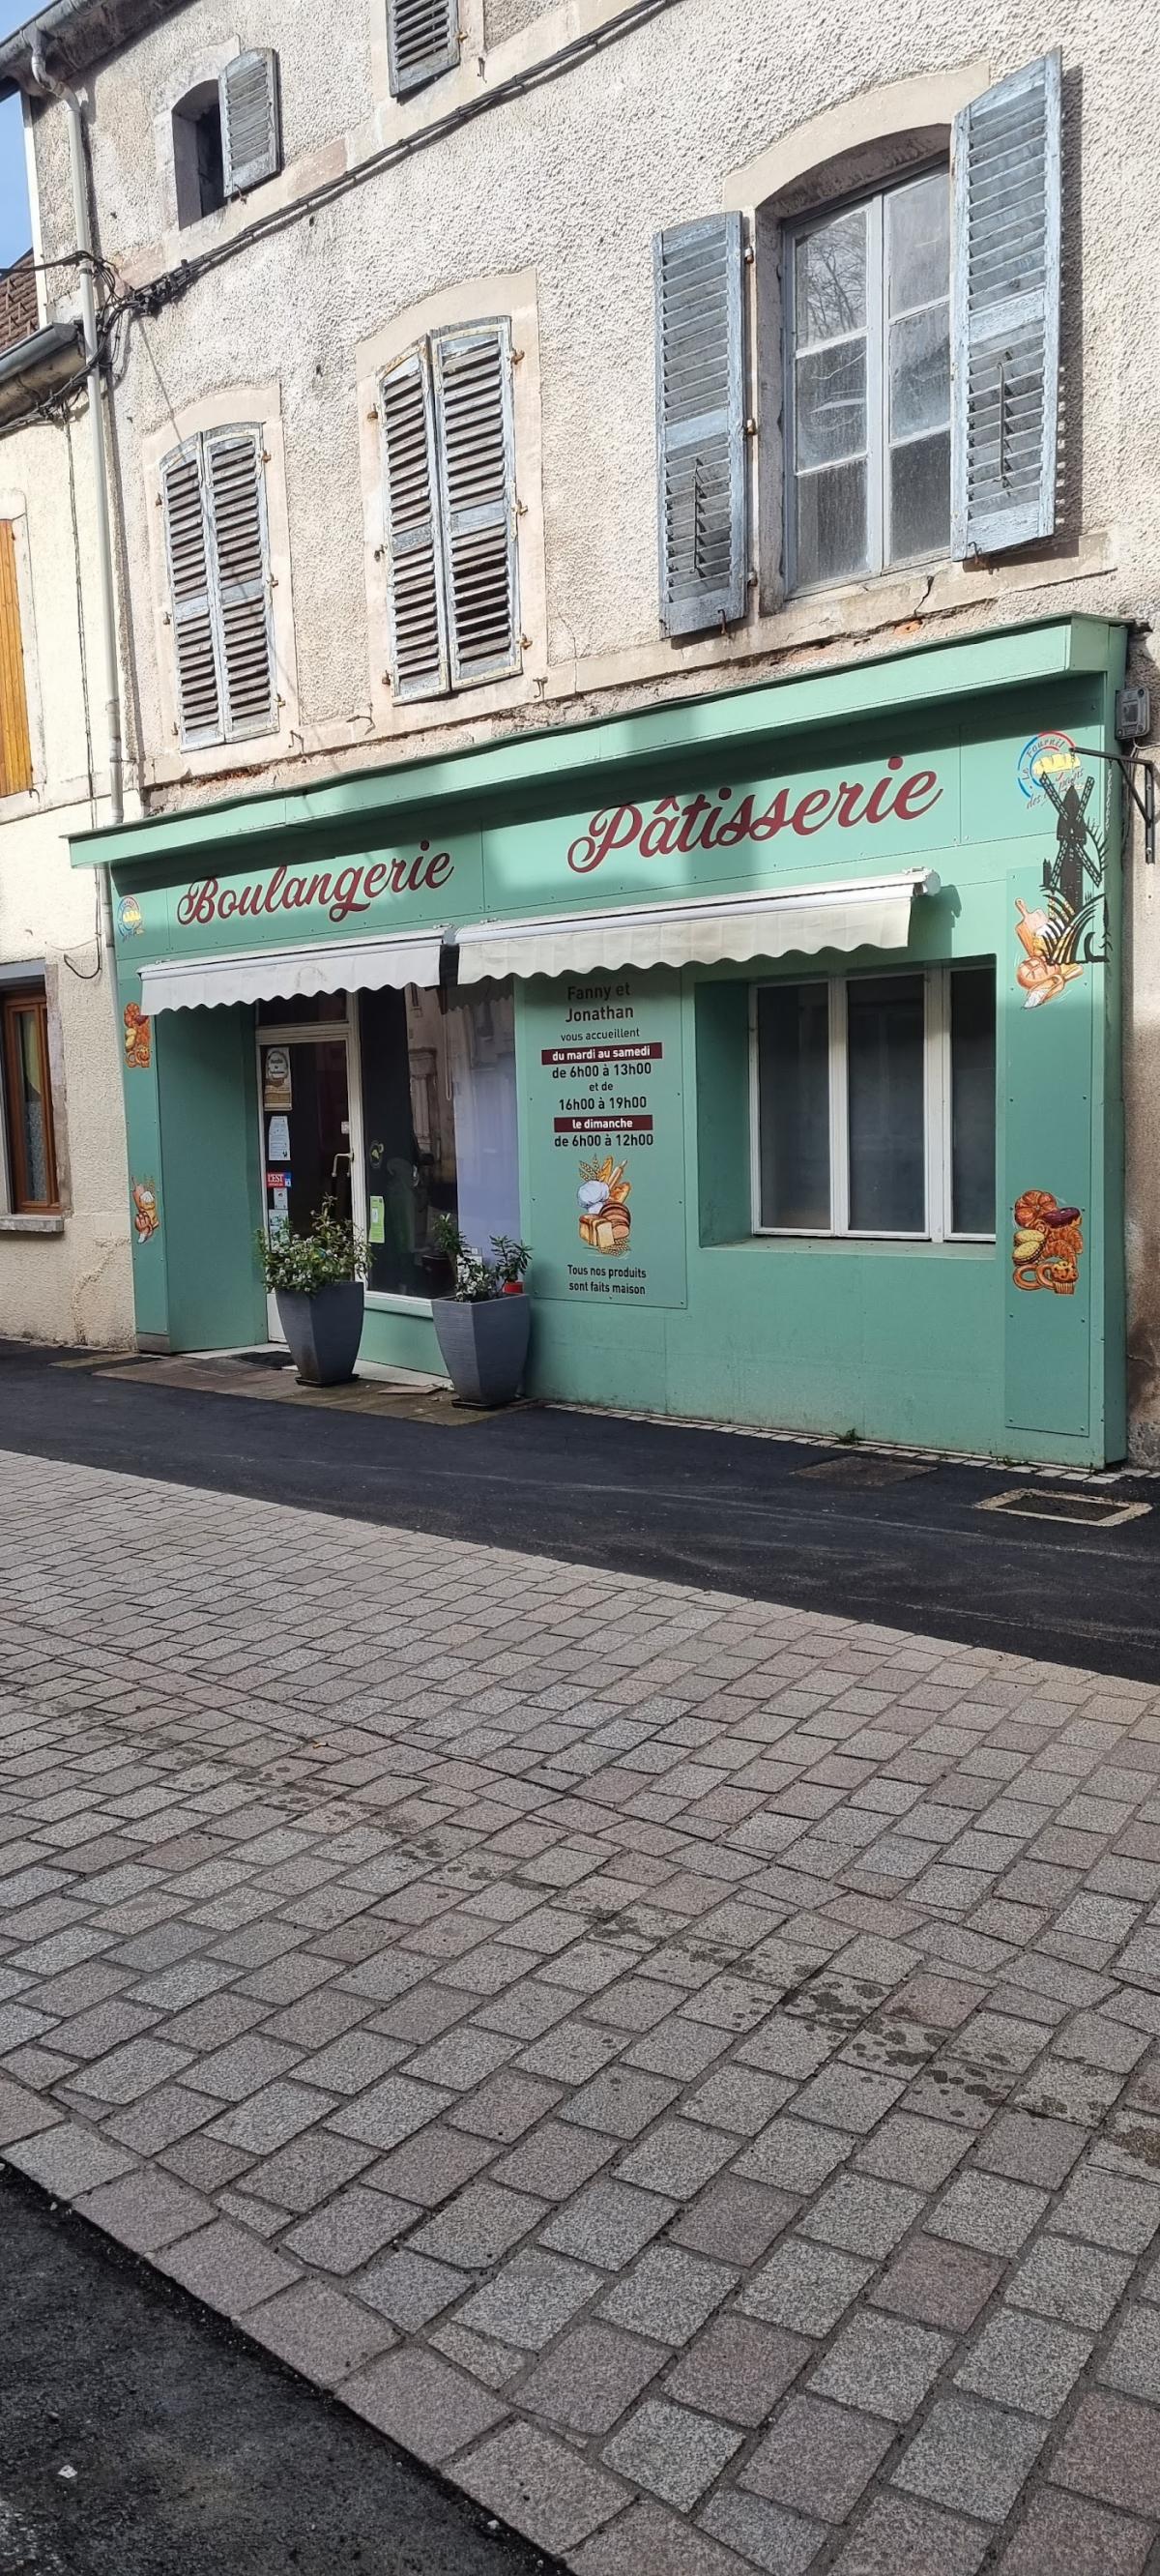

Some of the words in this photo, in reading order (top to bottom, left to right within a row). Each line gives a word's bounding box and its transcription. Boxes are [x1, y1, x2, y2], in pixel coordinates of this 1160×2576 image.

[1027, 738, 1065, 758] Fournil
[177, 840, 454, 924] Boulangerie
[567, 755, 943, 873] Pâtisserie
[567, 986, 611, 1001] Fanny
[616, 982, 630, 996] et
[566, 1006, 634, 1023] Jonathan
[561, 1032, 583, 1041] vous
[586, 1026, 640, 1040] accueillent
[552, 1051, 565, 1062] du
[566, 1049, 595, 1060] mardi
[597, 1049, 611, 1059] au
[613, 1045, 651, 1058] samedi
[552, 1068, 566, 1078] de
[569, 1066, 599, 1078] 6h00
[602, 1064, 610, 1076] à
[614, 1062, 652, 1075] 13h00
[589, 1082, 599, 1092] et
[601, 1081, 614, 1091] de
[559, 1098, 595, 1111] 16h00
[597, 1097, 605, 1109] à
[609, 1097, 647, 1109] 19h00
[572, 1119, 582, 1128] le
[584, 1118, 633, 1128] dimanche
[554, 1135, 568, 1147] de
[571, 1135, 601, 1147] 6h00
[604, 1134, 612, 1146] à
[616, 1133, 653, 1146] 12h00
[566, 1264, 589, 1275] Tous
[591, 1268, 606, 1276] nos
[608, 1266, 647, 1279] produits
[568, 1281, 589, 1292] sont
[591, 1281, 610, 1293] faits
[612, 1283, 646, 1295] maison
